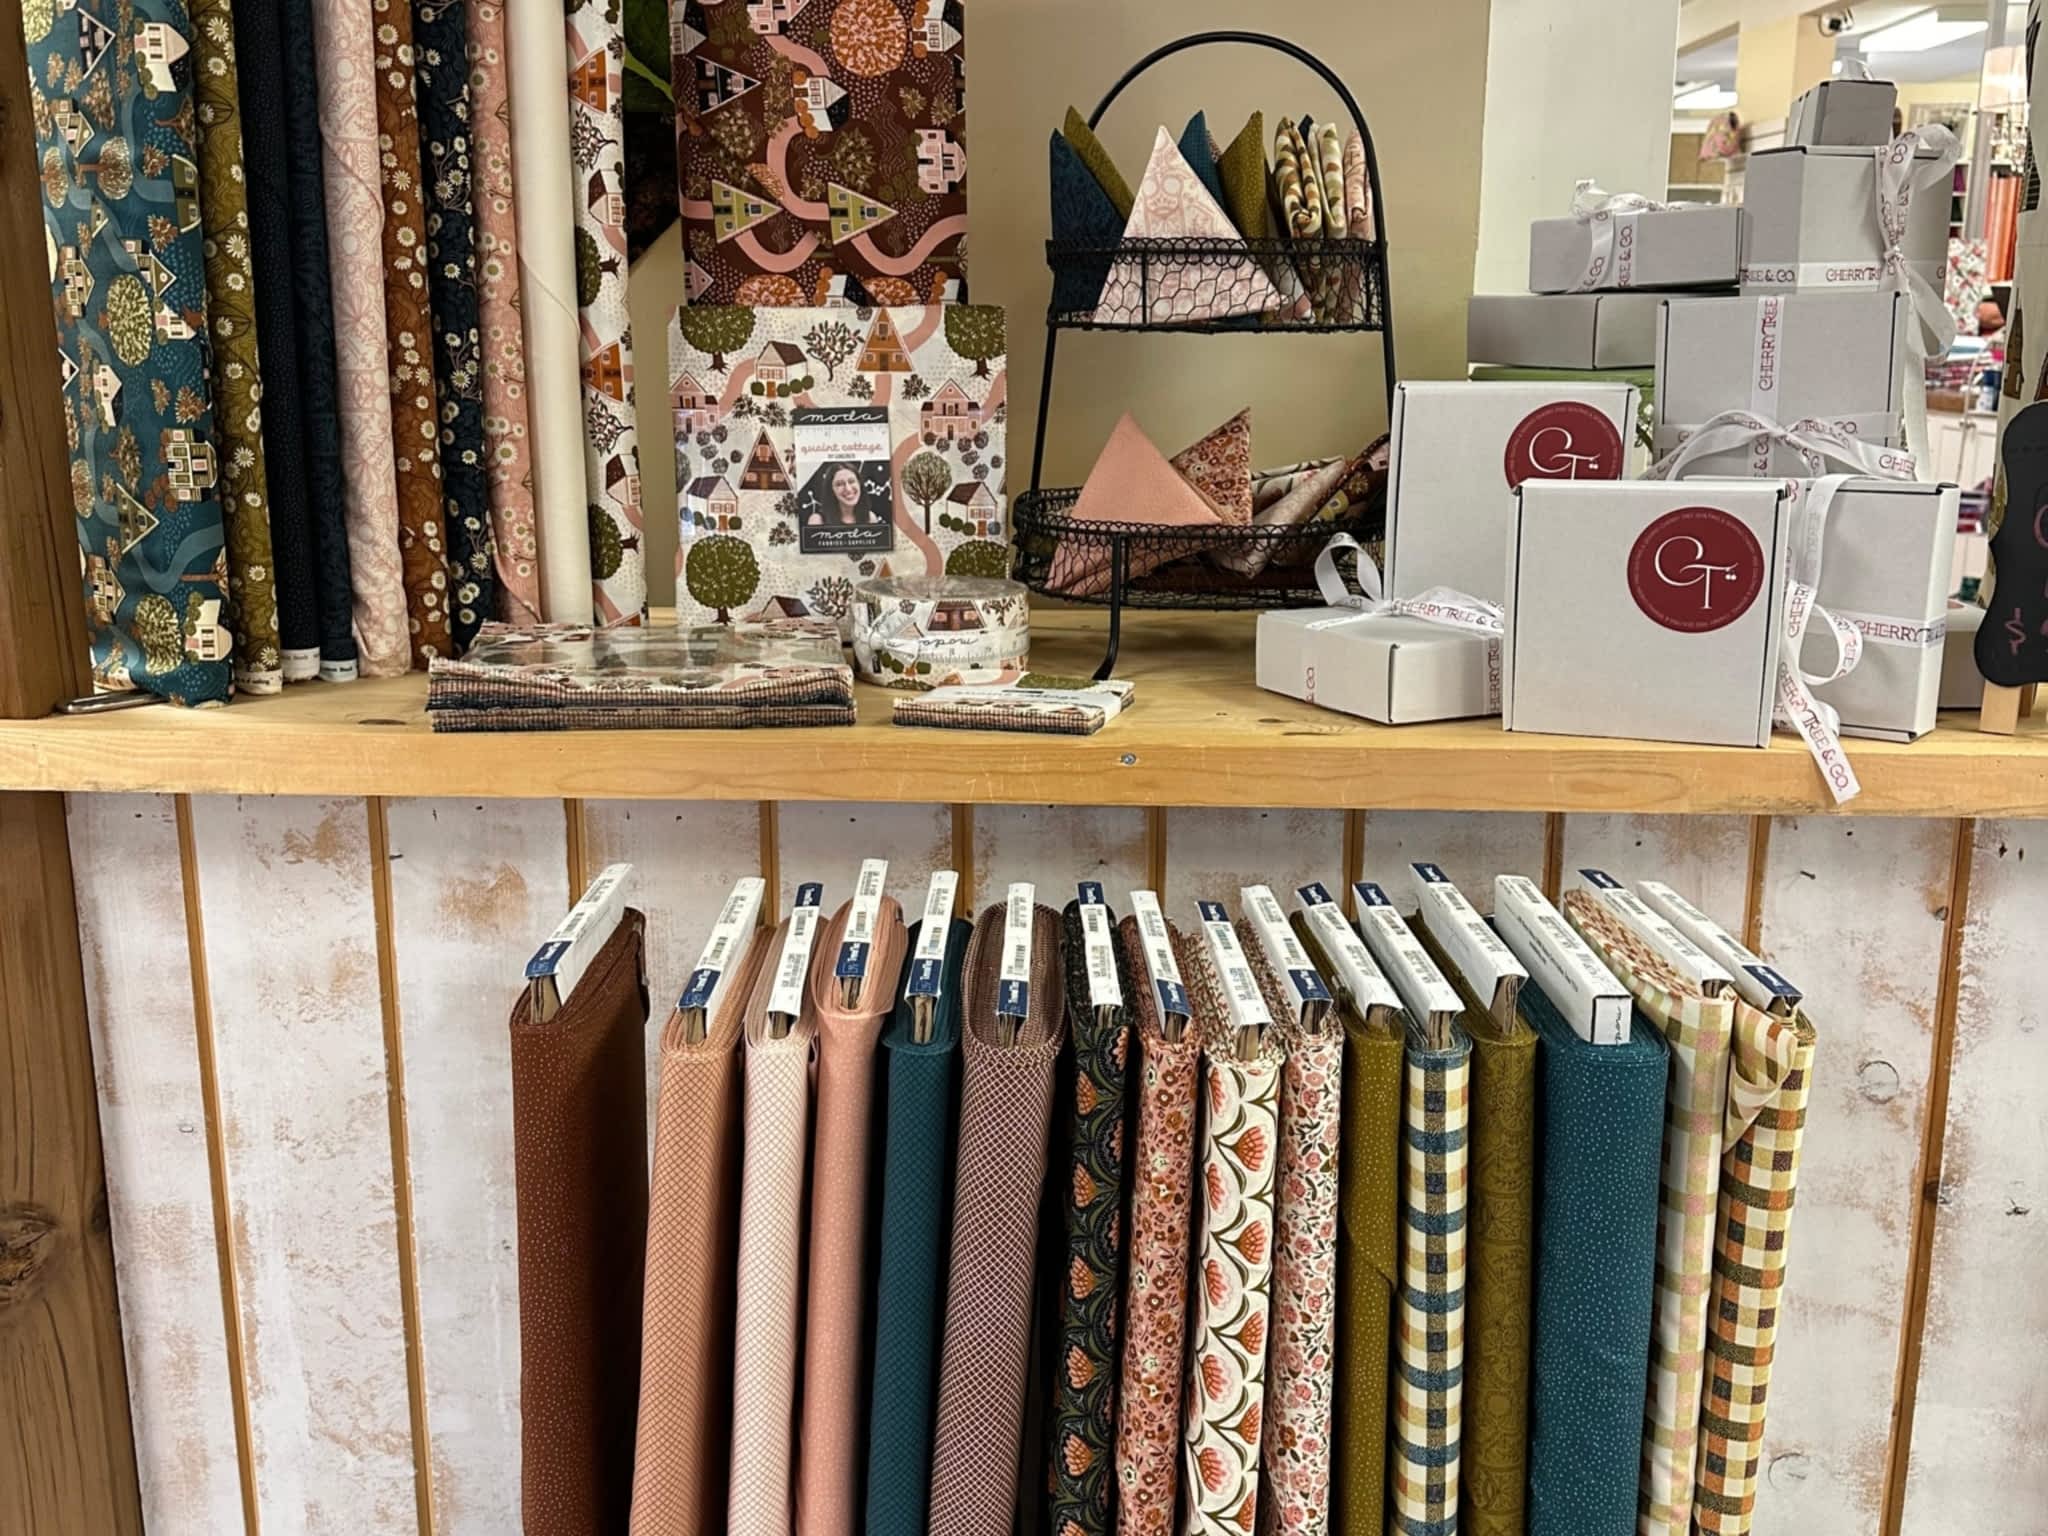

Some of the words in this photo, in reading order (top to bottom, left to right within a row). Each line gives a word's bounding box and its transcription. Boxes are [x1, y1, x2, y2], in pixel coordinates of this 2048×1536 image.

[800, 410, 883, 422] moda
[801, 443, 840, 454] quaint
[841, 442, 884, 453] cottage
[810, 528, 882, 540] moda
[1821, 749, 1837, 766] &
